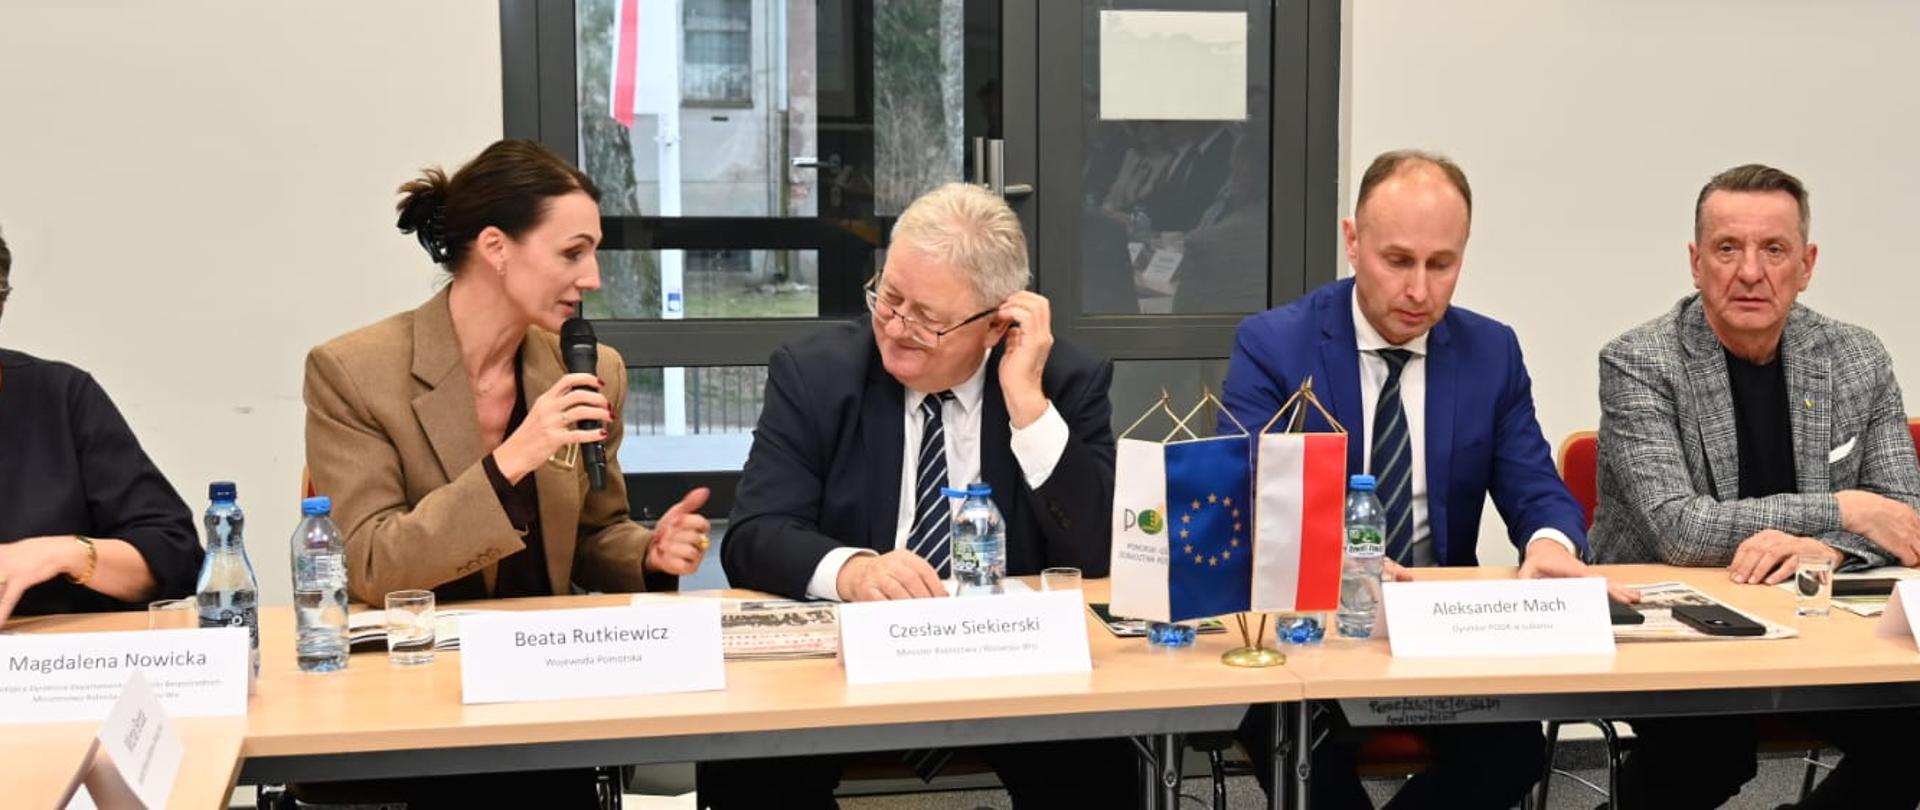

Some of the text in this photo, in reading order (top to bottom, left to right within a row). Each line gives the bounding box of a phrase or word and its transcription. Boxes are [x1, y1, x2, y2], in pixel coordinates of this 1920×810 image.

[1432, 597, 1567, 616] Aleksander Mach
[514, 625, 669, 647] Beata Rutkiewicz
[889, 617, 1040, 638] Czesław Siekierski
[9, 650, 207, 674] Magdalena Nowicka
[545, 654, 643, 667] Wojewoda Pomorska
